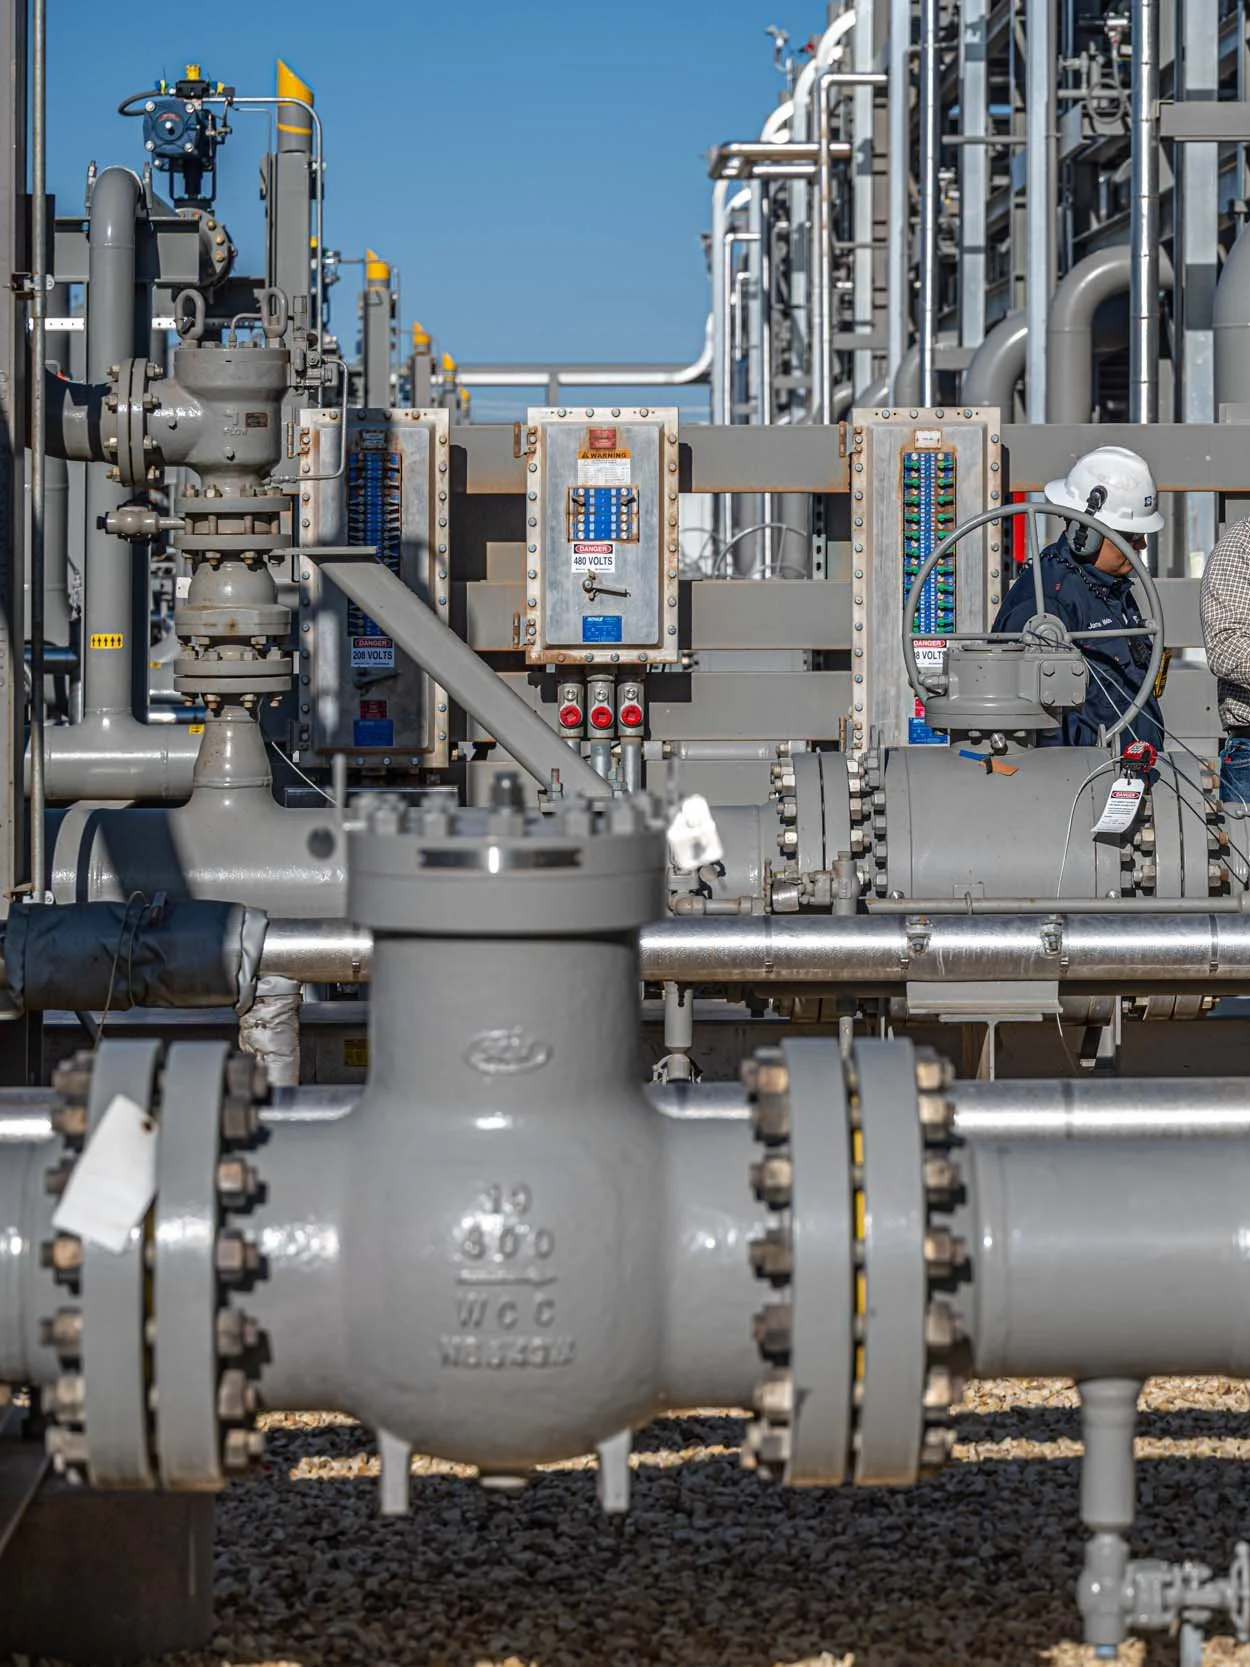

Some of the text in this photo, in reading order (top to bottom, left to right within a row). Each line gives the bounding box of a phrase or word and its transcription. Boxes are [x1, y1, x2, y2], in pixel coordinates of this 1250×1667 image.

[573, 556, 613, 566] 480 VOLTS
[353, 651, 392, 660] 208 VOLTS
